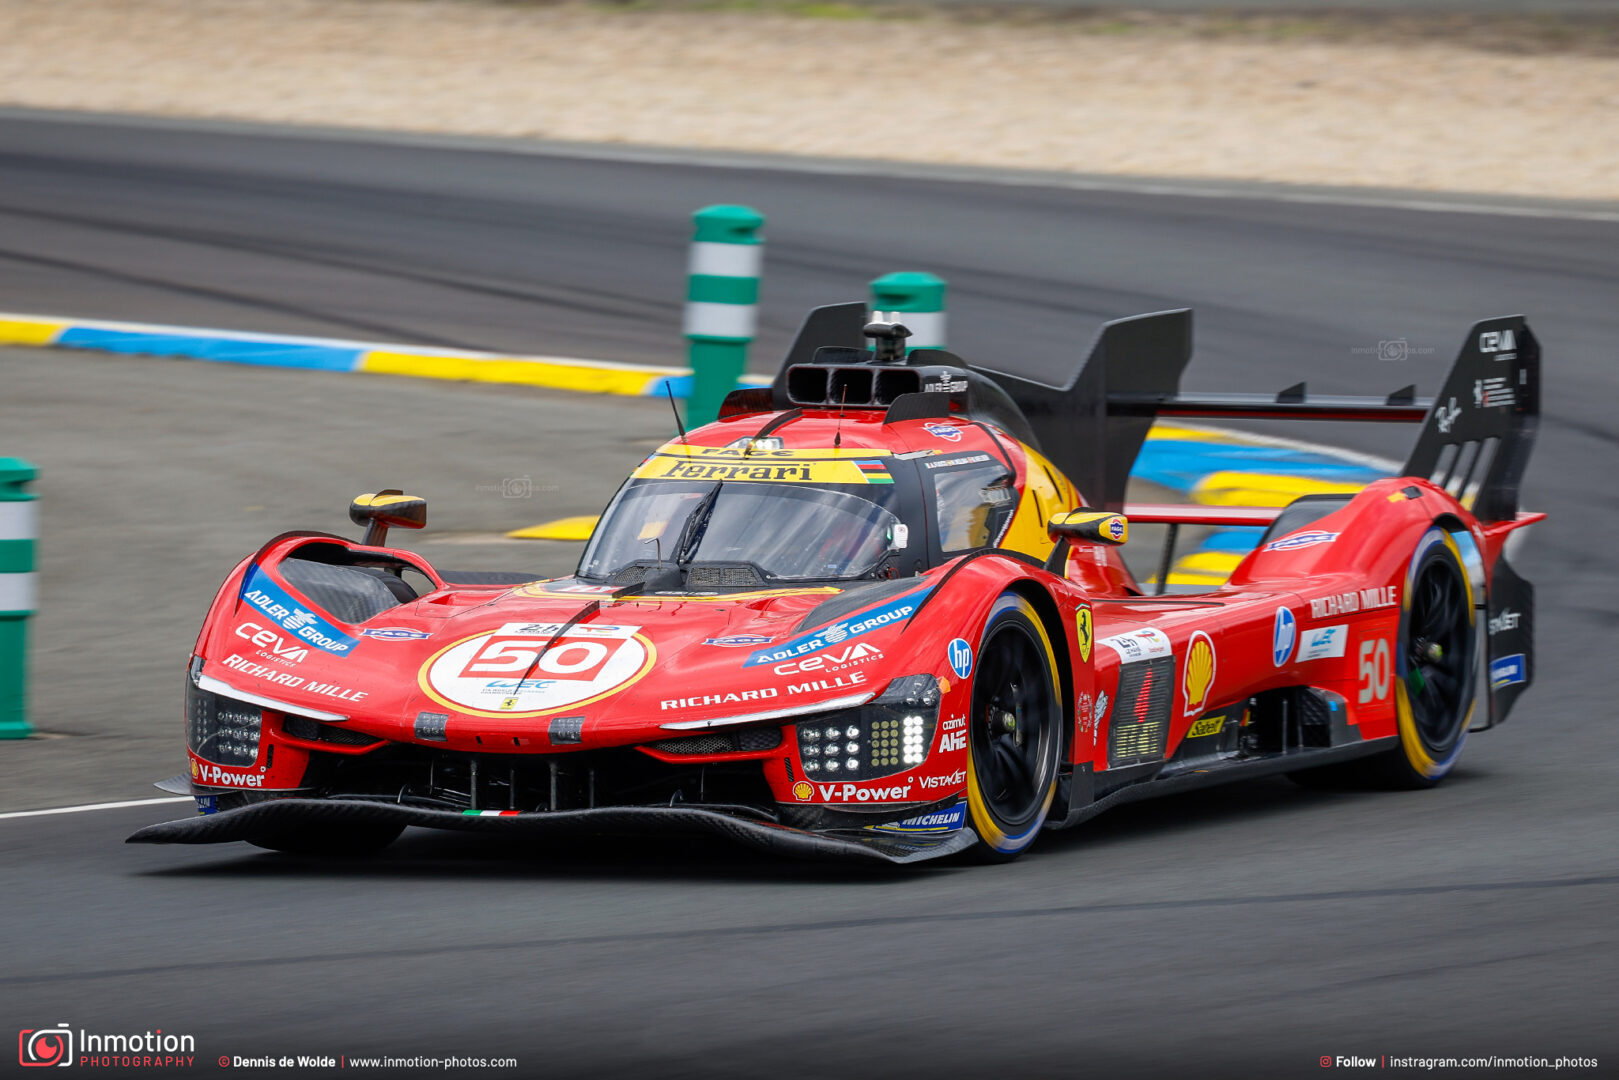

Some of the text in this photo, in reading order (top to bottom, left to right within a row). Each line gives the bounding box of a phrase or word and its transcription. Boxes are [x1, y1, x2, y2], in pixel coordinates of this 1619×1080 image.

[660, 461, 812, 481] Ferrari
[1310, 586, 1397, 619] RICHARD MILLE
[244, 589, 350, 653] ADLER GROUP
[757, 605, 913, 663] ADLER GROUP
[255, 650, 297, 668] LOGISTICS
[469, 641, 608, 674] 50
[825, 653, 884, 673] LOGISTICS
[953, 638, 970, 678] hp
[1358, 638, 1390, 704] 50
[222, 654, 369, 702] RICHARD MILLE
[661, 671, 867, 710] RICHARD MILLE
[199, 764, 265, 787] V-Power
[818, 783, 911, 802] V-Power
[902, 811, 961, 826] MICHELIN
